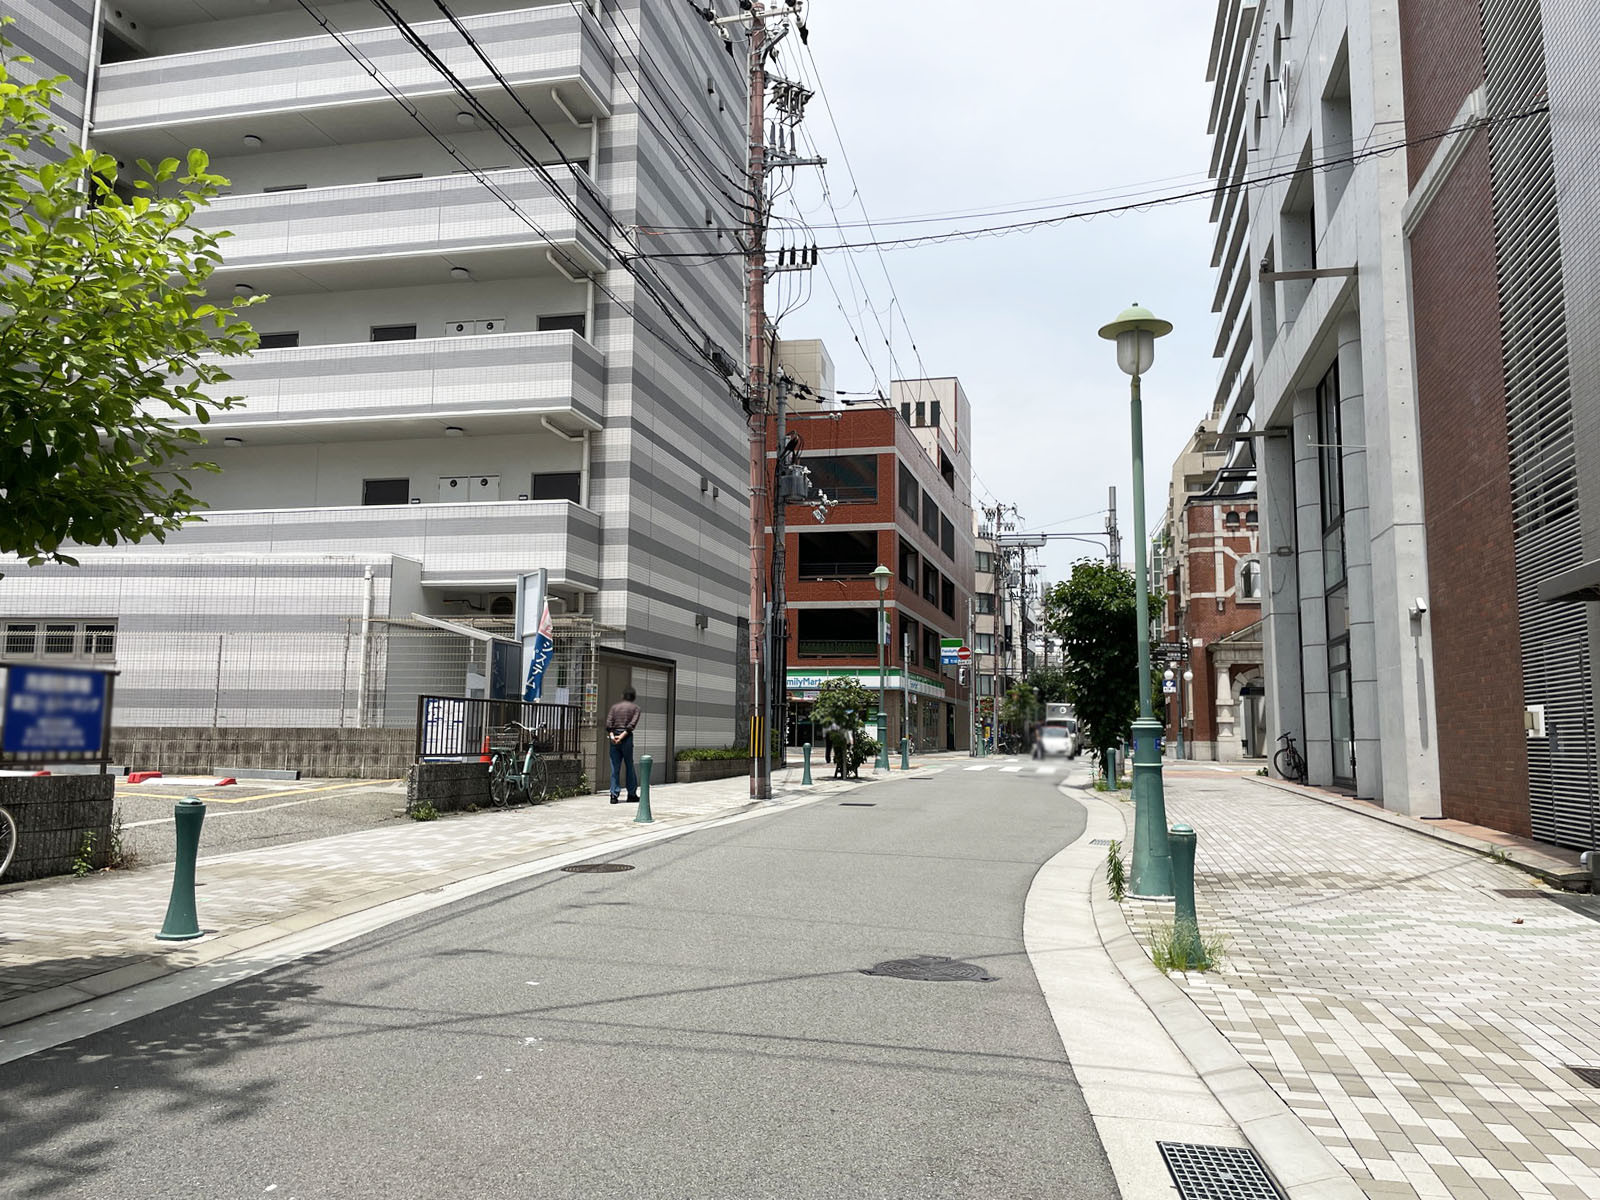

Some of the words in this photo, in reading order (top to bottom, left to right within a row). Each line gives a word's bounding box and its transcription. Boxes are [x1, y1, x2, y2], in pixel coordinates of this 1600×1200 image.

[523, 641, 553, 689] システム
[787, 677, 822, 687] milyMart
